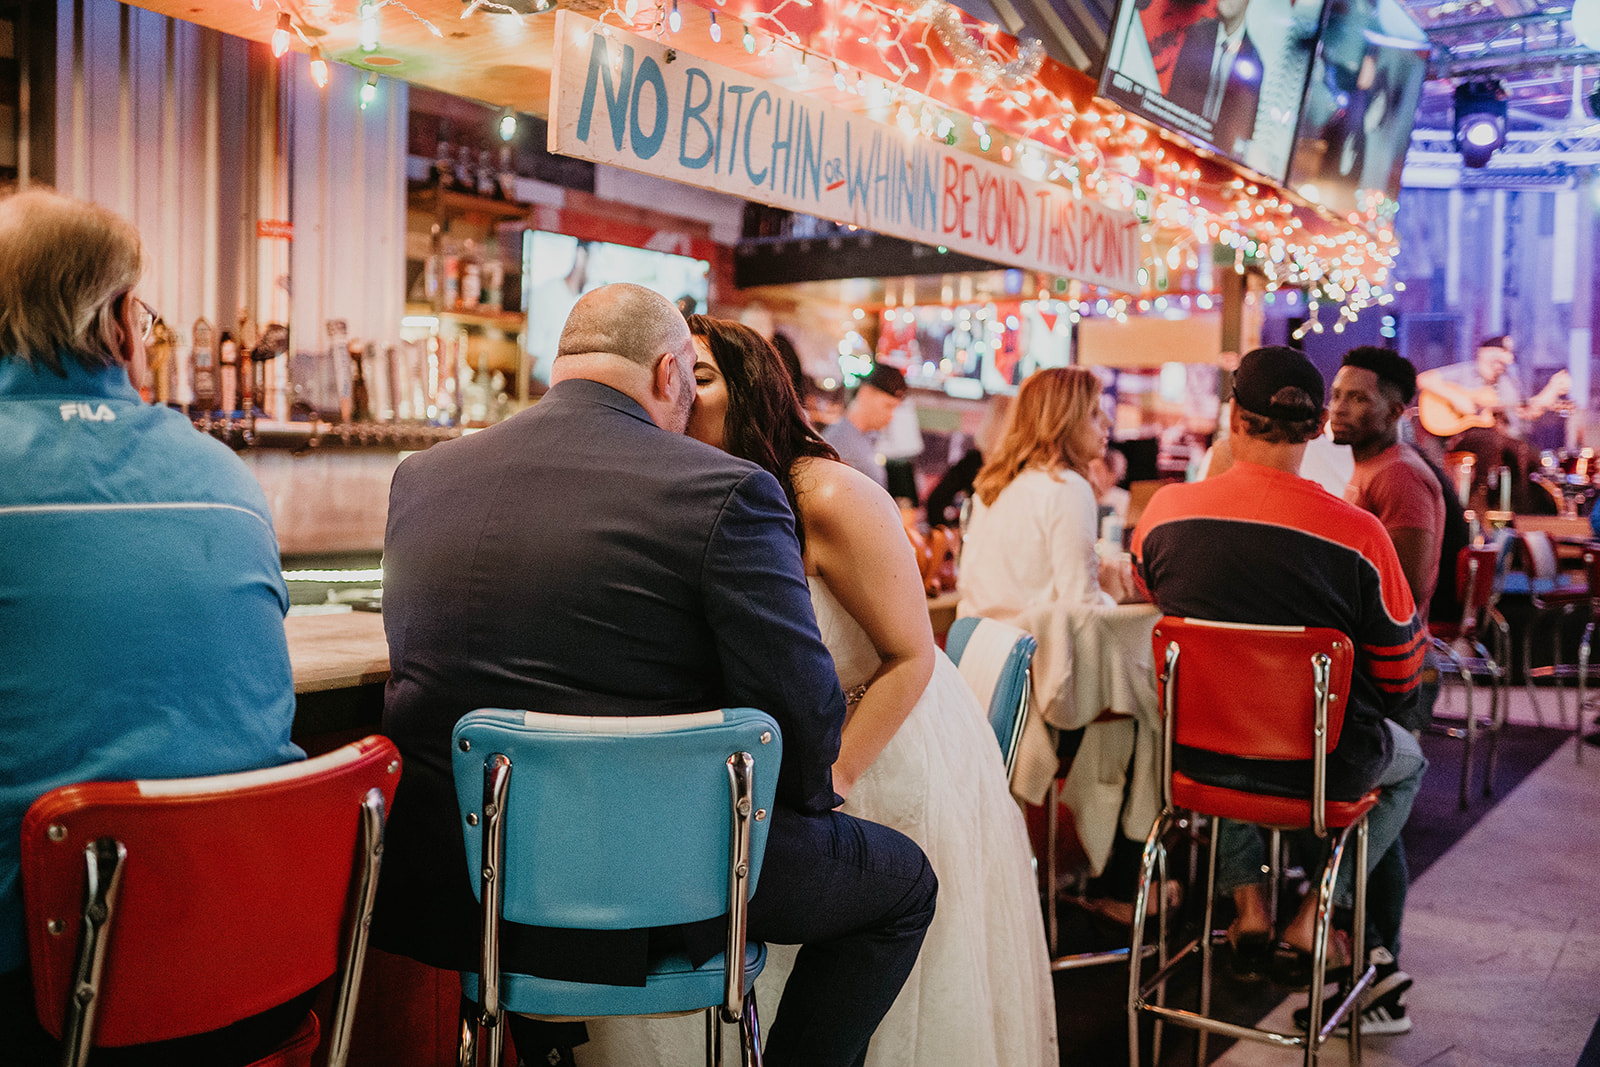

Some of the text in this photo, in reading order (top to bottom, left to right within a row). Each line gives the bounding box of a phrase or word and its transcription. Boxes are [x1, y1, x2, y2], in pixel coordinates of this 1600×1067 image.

[577, 33, 668, 160] NO
[678, 67, 824, 202] BITCHIN
[847, 121, 939, 232] WHININ
[942, 156, 1029, 254] BEYOND
[1035, 190, 1077, 272] THIS
[1079, 205, 1139, 284] POINT
[59, 403, 116, 421] FILA
